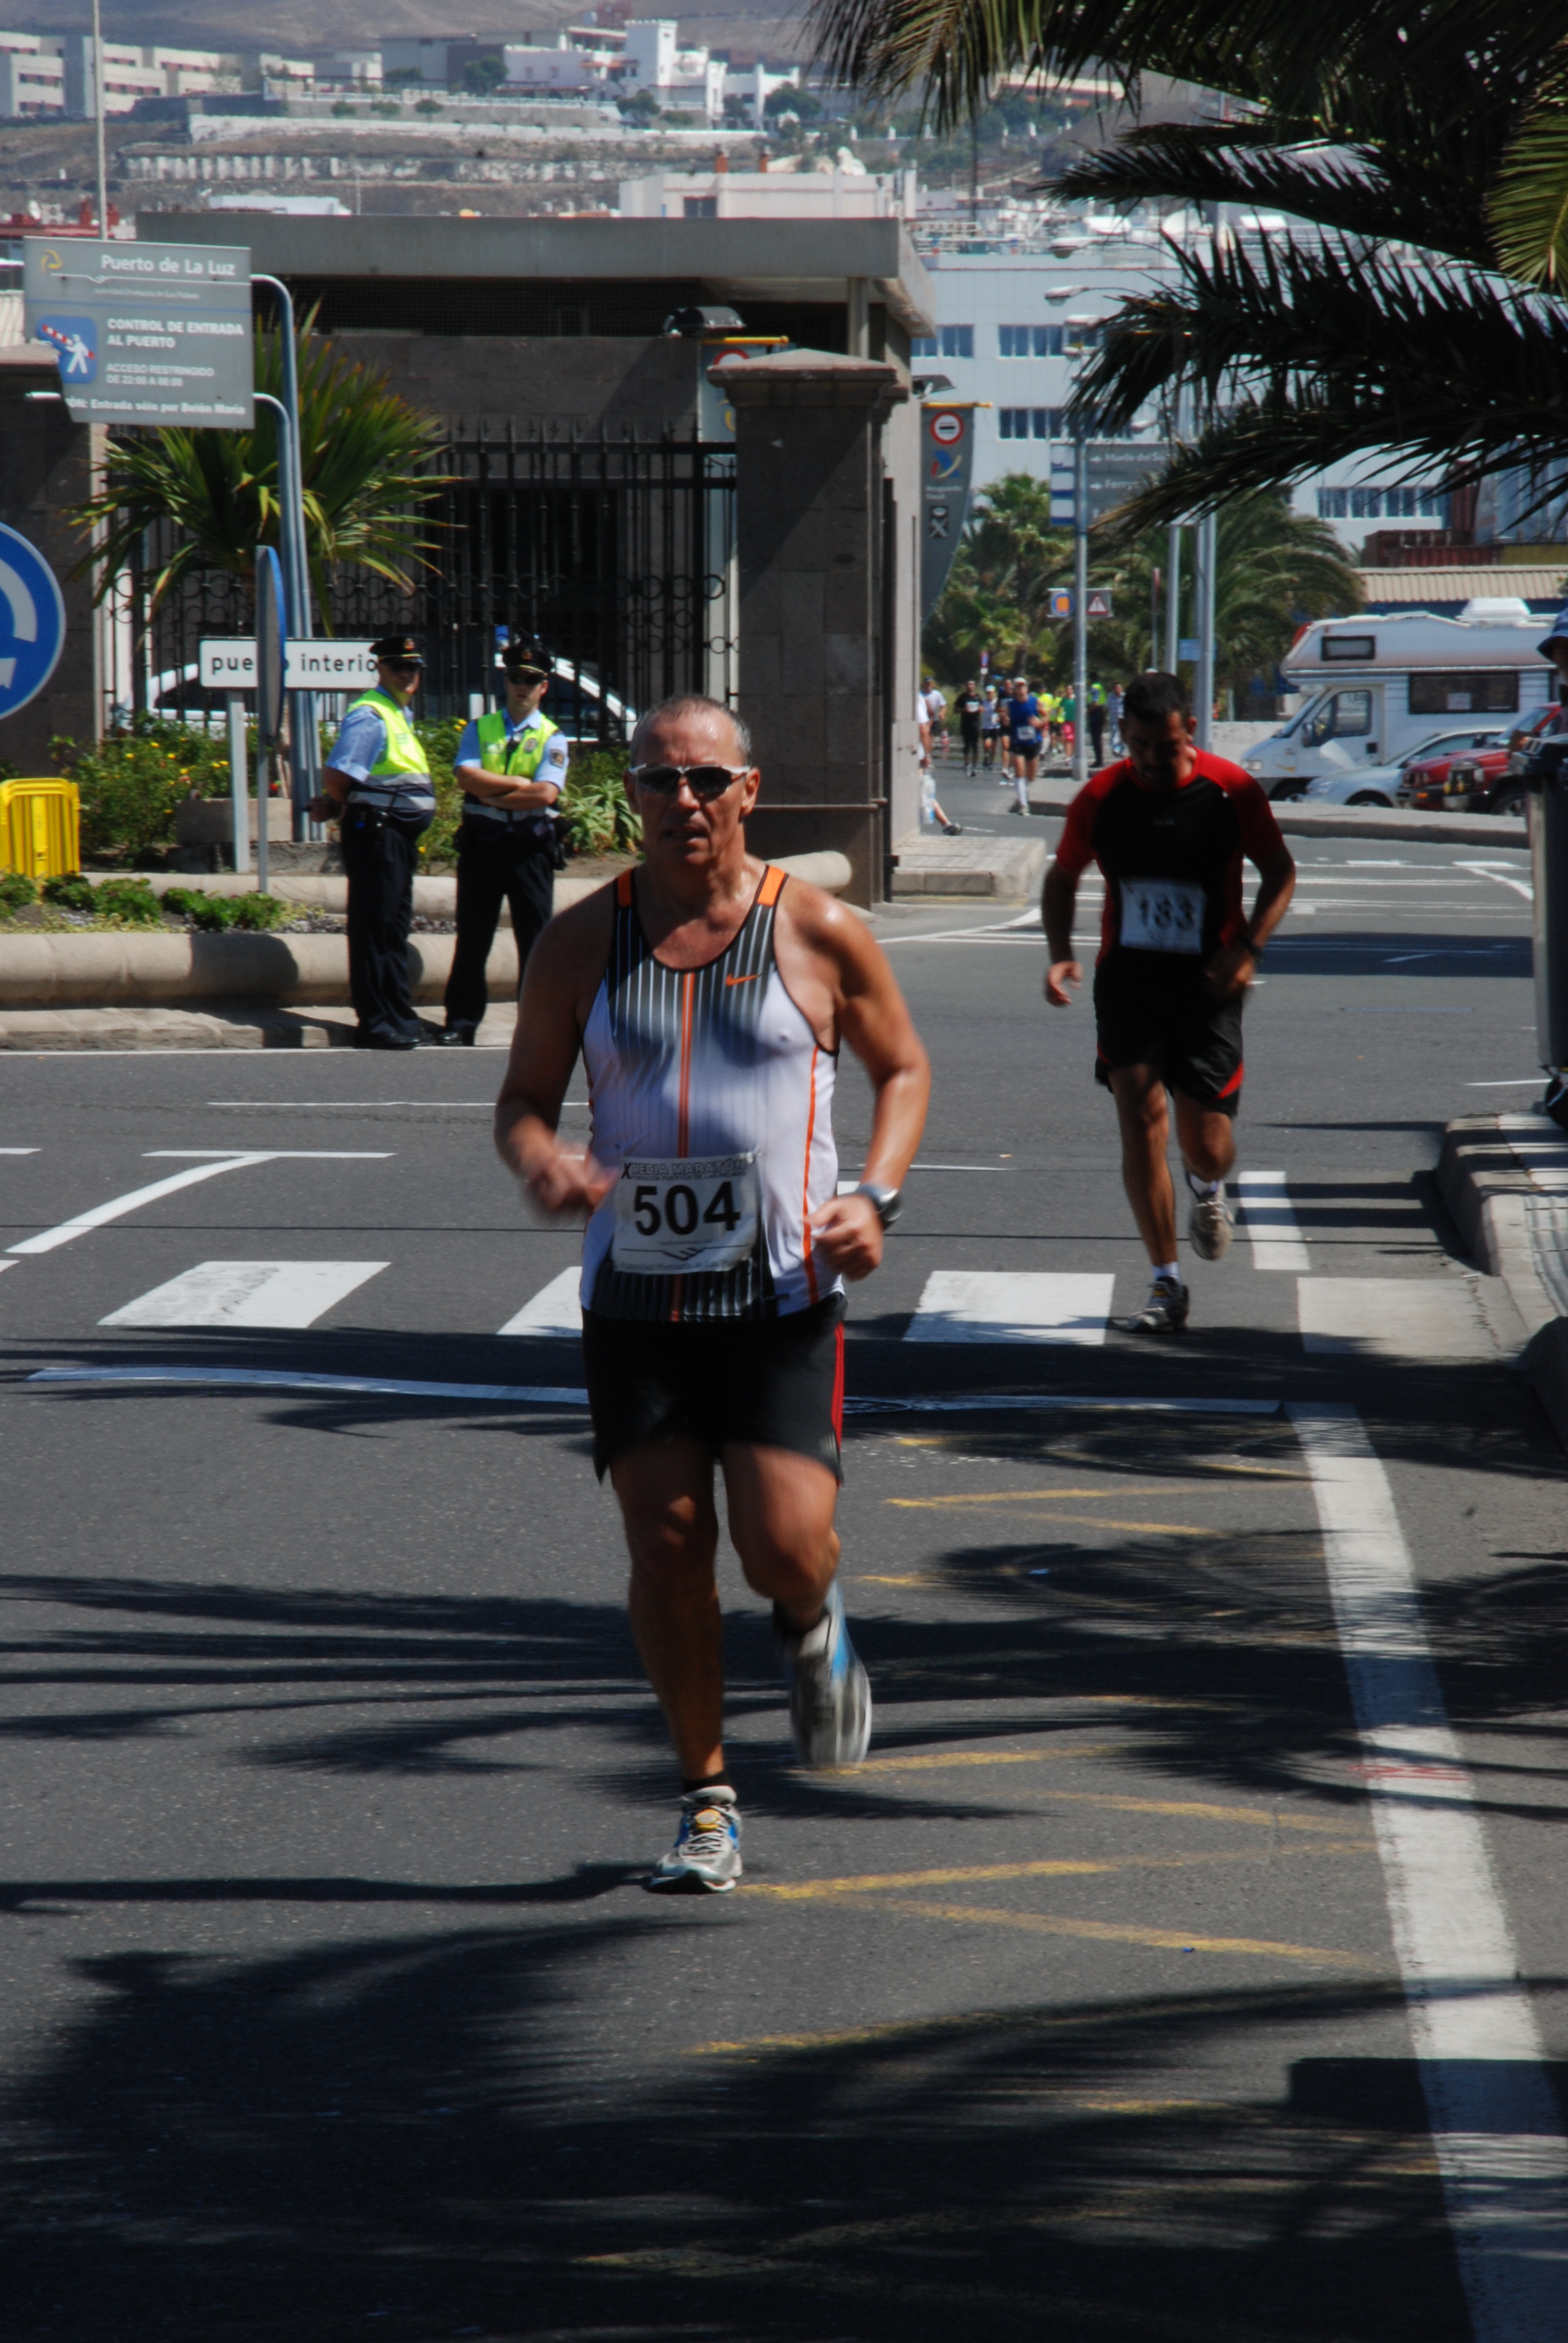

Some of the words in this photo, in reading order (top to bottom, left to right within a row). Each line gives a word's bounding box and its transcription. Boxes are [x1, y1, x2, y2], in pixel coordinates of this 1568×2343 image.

[101, 254, 154, 271] Puerto
[159, 257, 180, 272] de
[185, 259, 203, 274] La
[208, 260, 235, 275] Luz
[107, 318, 165, 332] CONTROL
[167, 321, 184, 333] DE
[186, 322, 244, 335] ENTRADA
[106, 334, 123, 346] AL
[126, 335, 175, 348] PUERTO
[106, 363, 148, 375] ACCESO
[149, 365, 215, 376] RESTRINGIDO
[106, 375, 120, 384] DE
[90, 398, 133, 410] Entrada
[160, 403, 178, 413] por
[301, 654, 377, 672] interio
[621, 1162, 632, 1179] X
[631, 1162, 670, 1176] MEDIA
[635, 1181, 740, 1236] 504
